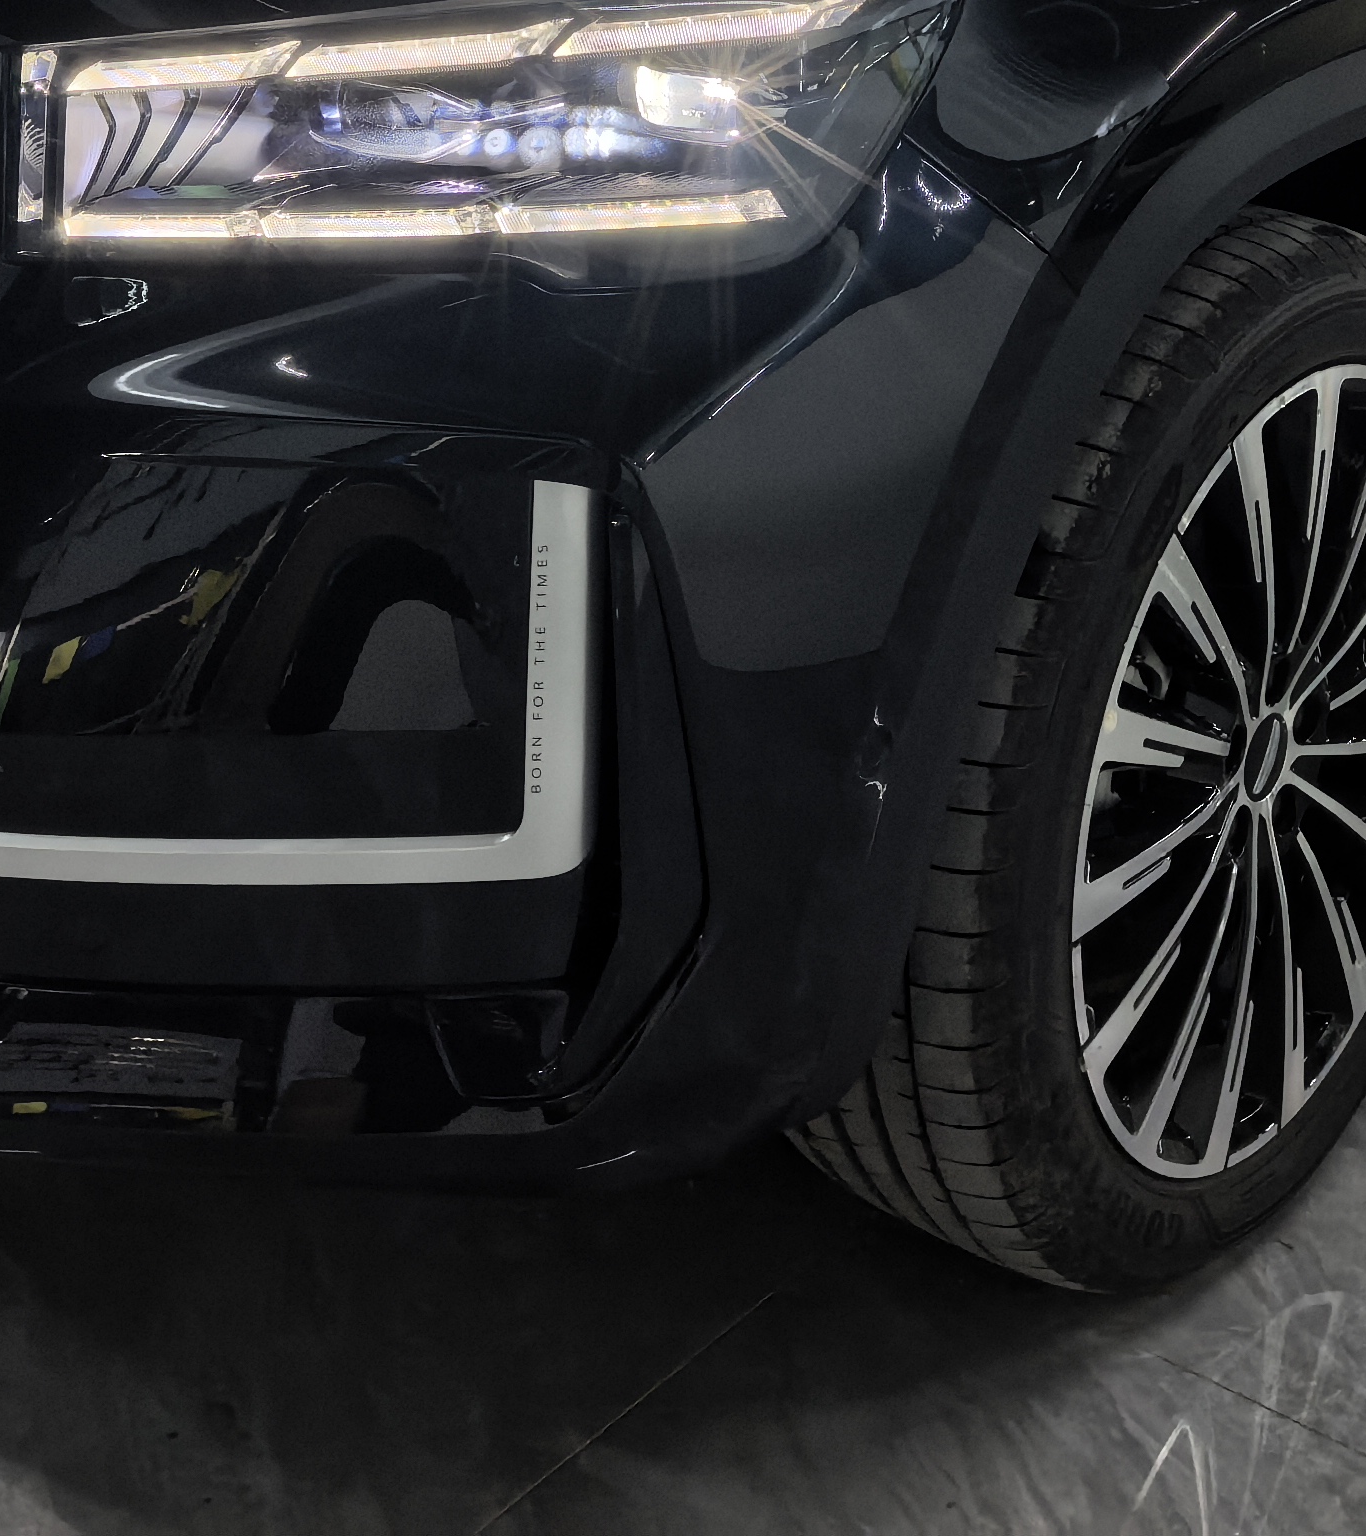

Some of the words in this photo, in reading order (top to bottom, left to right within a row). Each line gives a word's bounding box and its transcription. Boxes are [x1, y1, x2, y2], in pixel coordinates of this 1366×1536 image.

[536, 545, 549, 611] TIMES
[534, 626, 546, 666] THE
[532, 681, 545, 721] FOR
[530, 736, 543, 794] BORN
